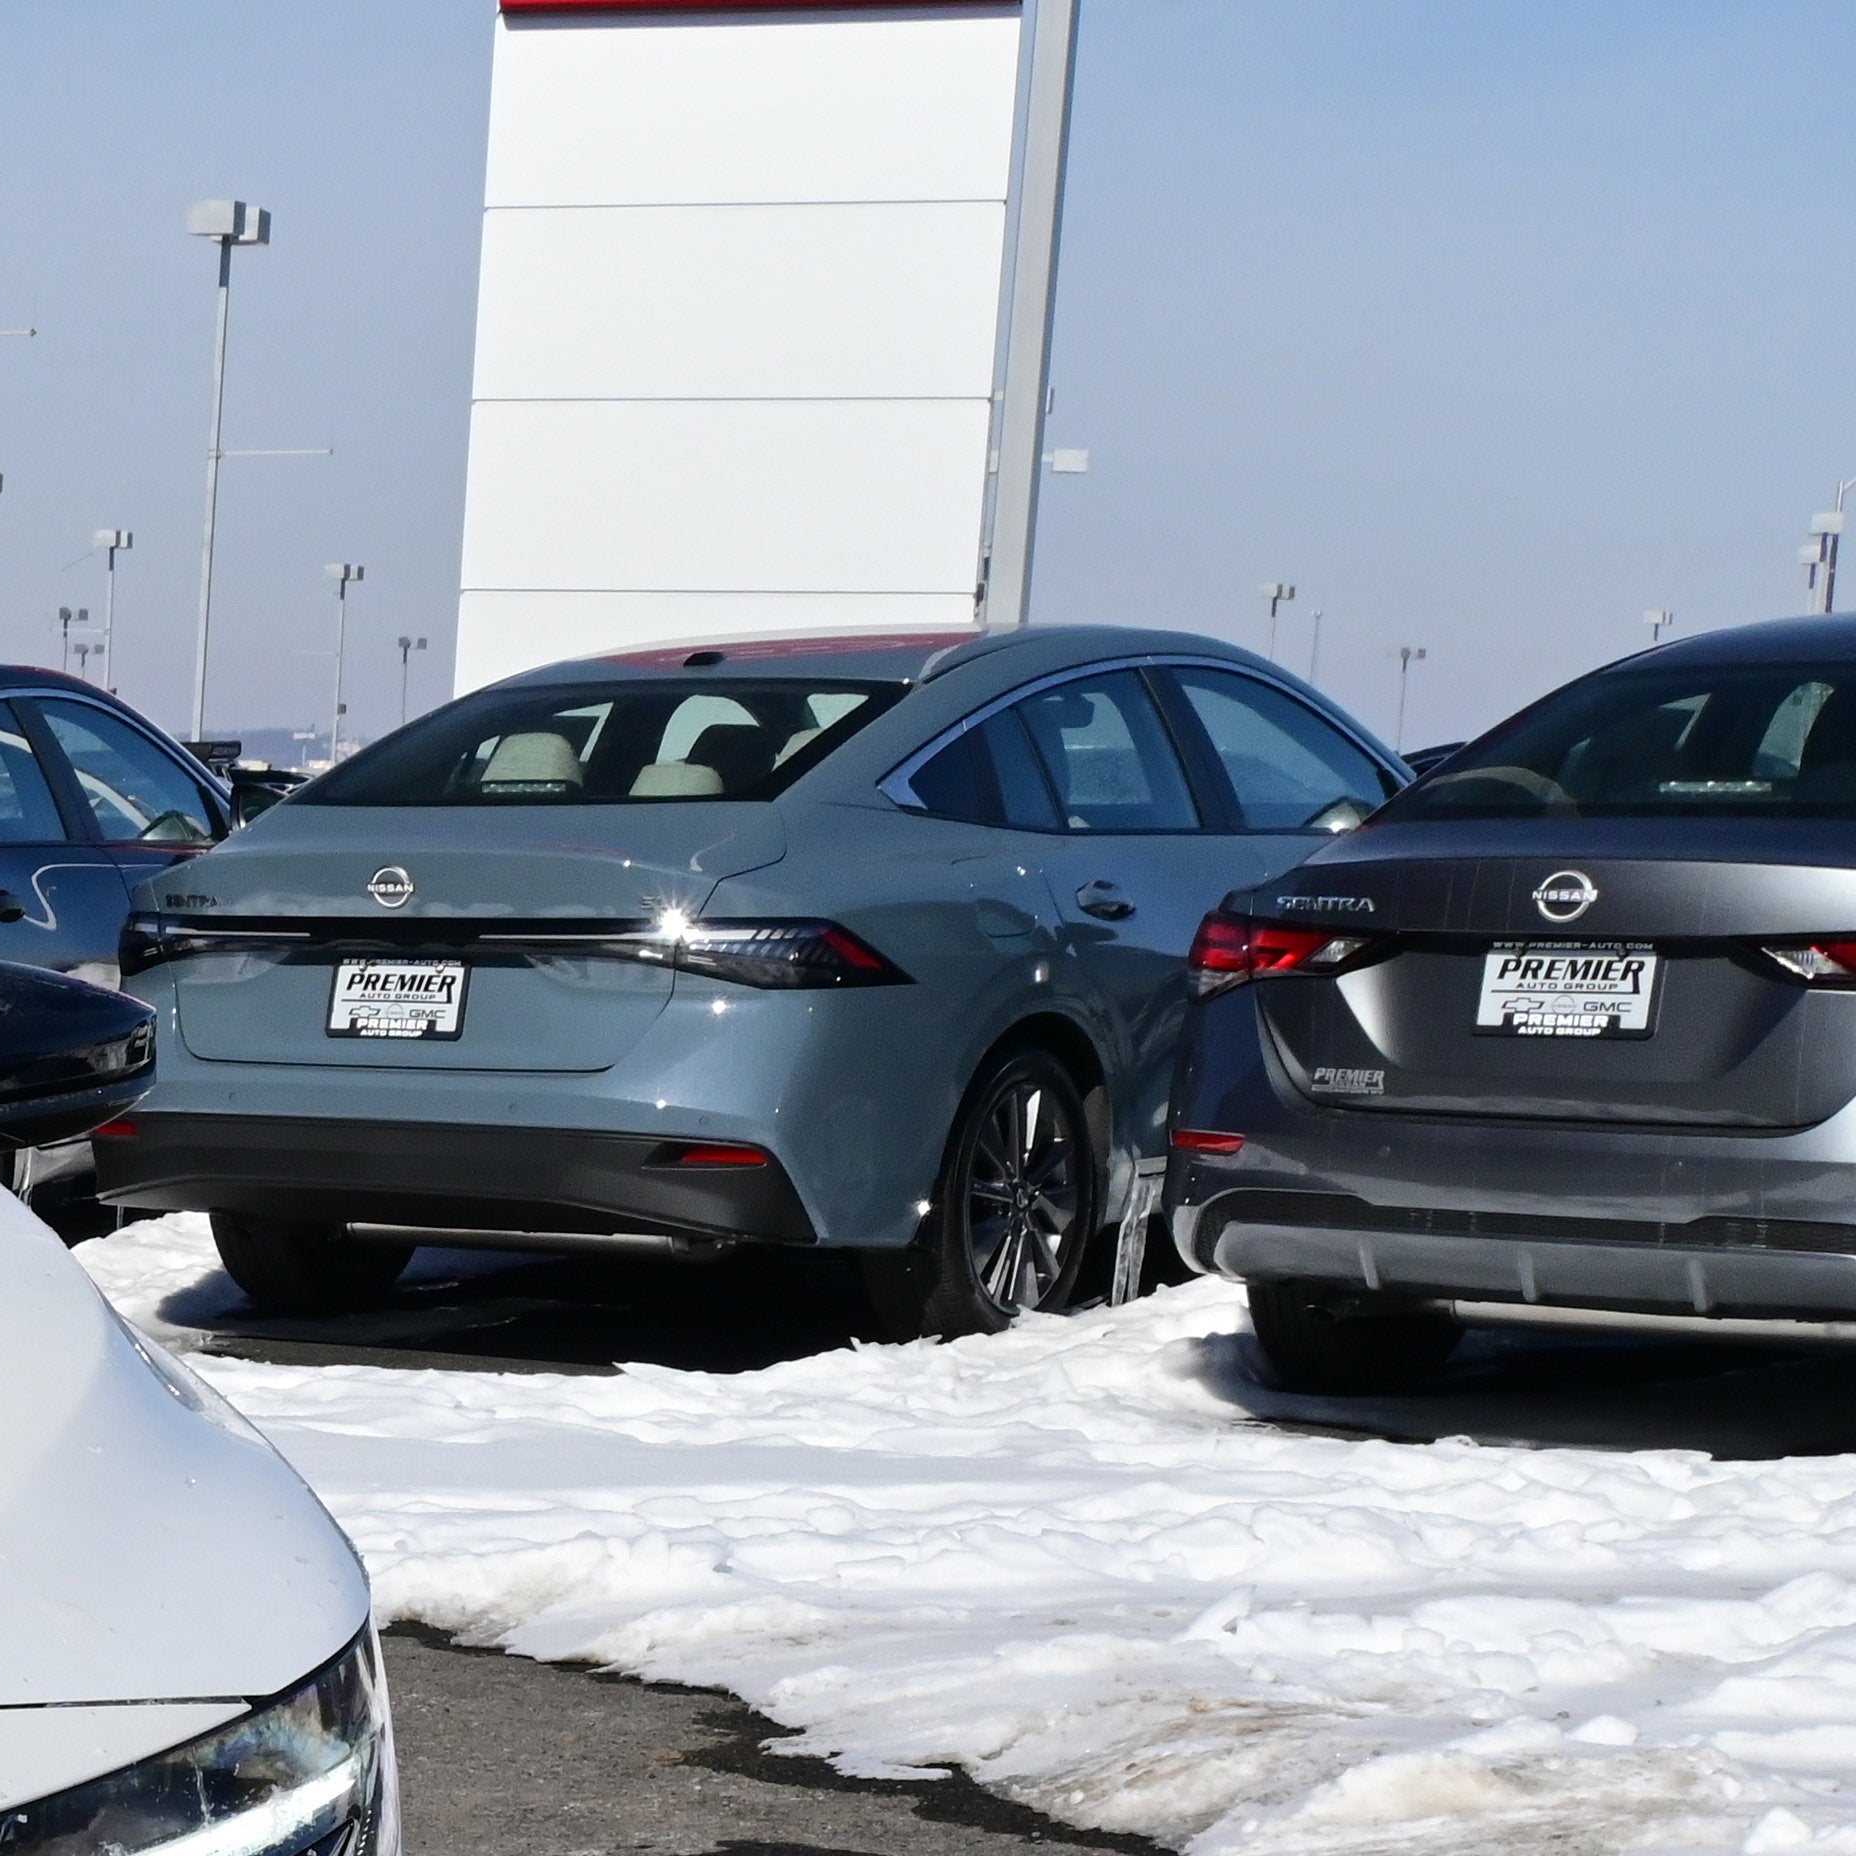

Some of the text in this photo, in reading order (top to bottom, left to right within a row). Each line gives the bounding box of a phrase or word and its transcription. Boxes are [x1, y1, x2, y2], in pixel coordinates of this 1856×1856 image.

[367, 883, 414, 893] NISSAN
[1532, 889, 1598, 902] NISSAN
[1493, 941, 1654, 950] WWW.PREMIER-AUTOCOM
[1497, 958, 1645, 994] PREMIER
[347, 973, 457, 1003] PREMIER
[1516, 982, 1618, 990] AUTO GROUP
[1583, 1001, 1632, 1012] GMC
[409, 1009, 446, 1019] GMC
[1512, 1012, 1610, 1027] PREMIER
[356, 1018, 429, 1030] PREMIER
[360, 1029, 423, 1037] AUTO GROUP
[1517, 1026, 1601, 1036] AUTO GROUP
[1314, 1067, 1385, 1089] PREMIER
